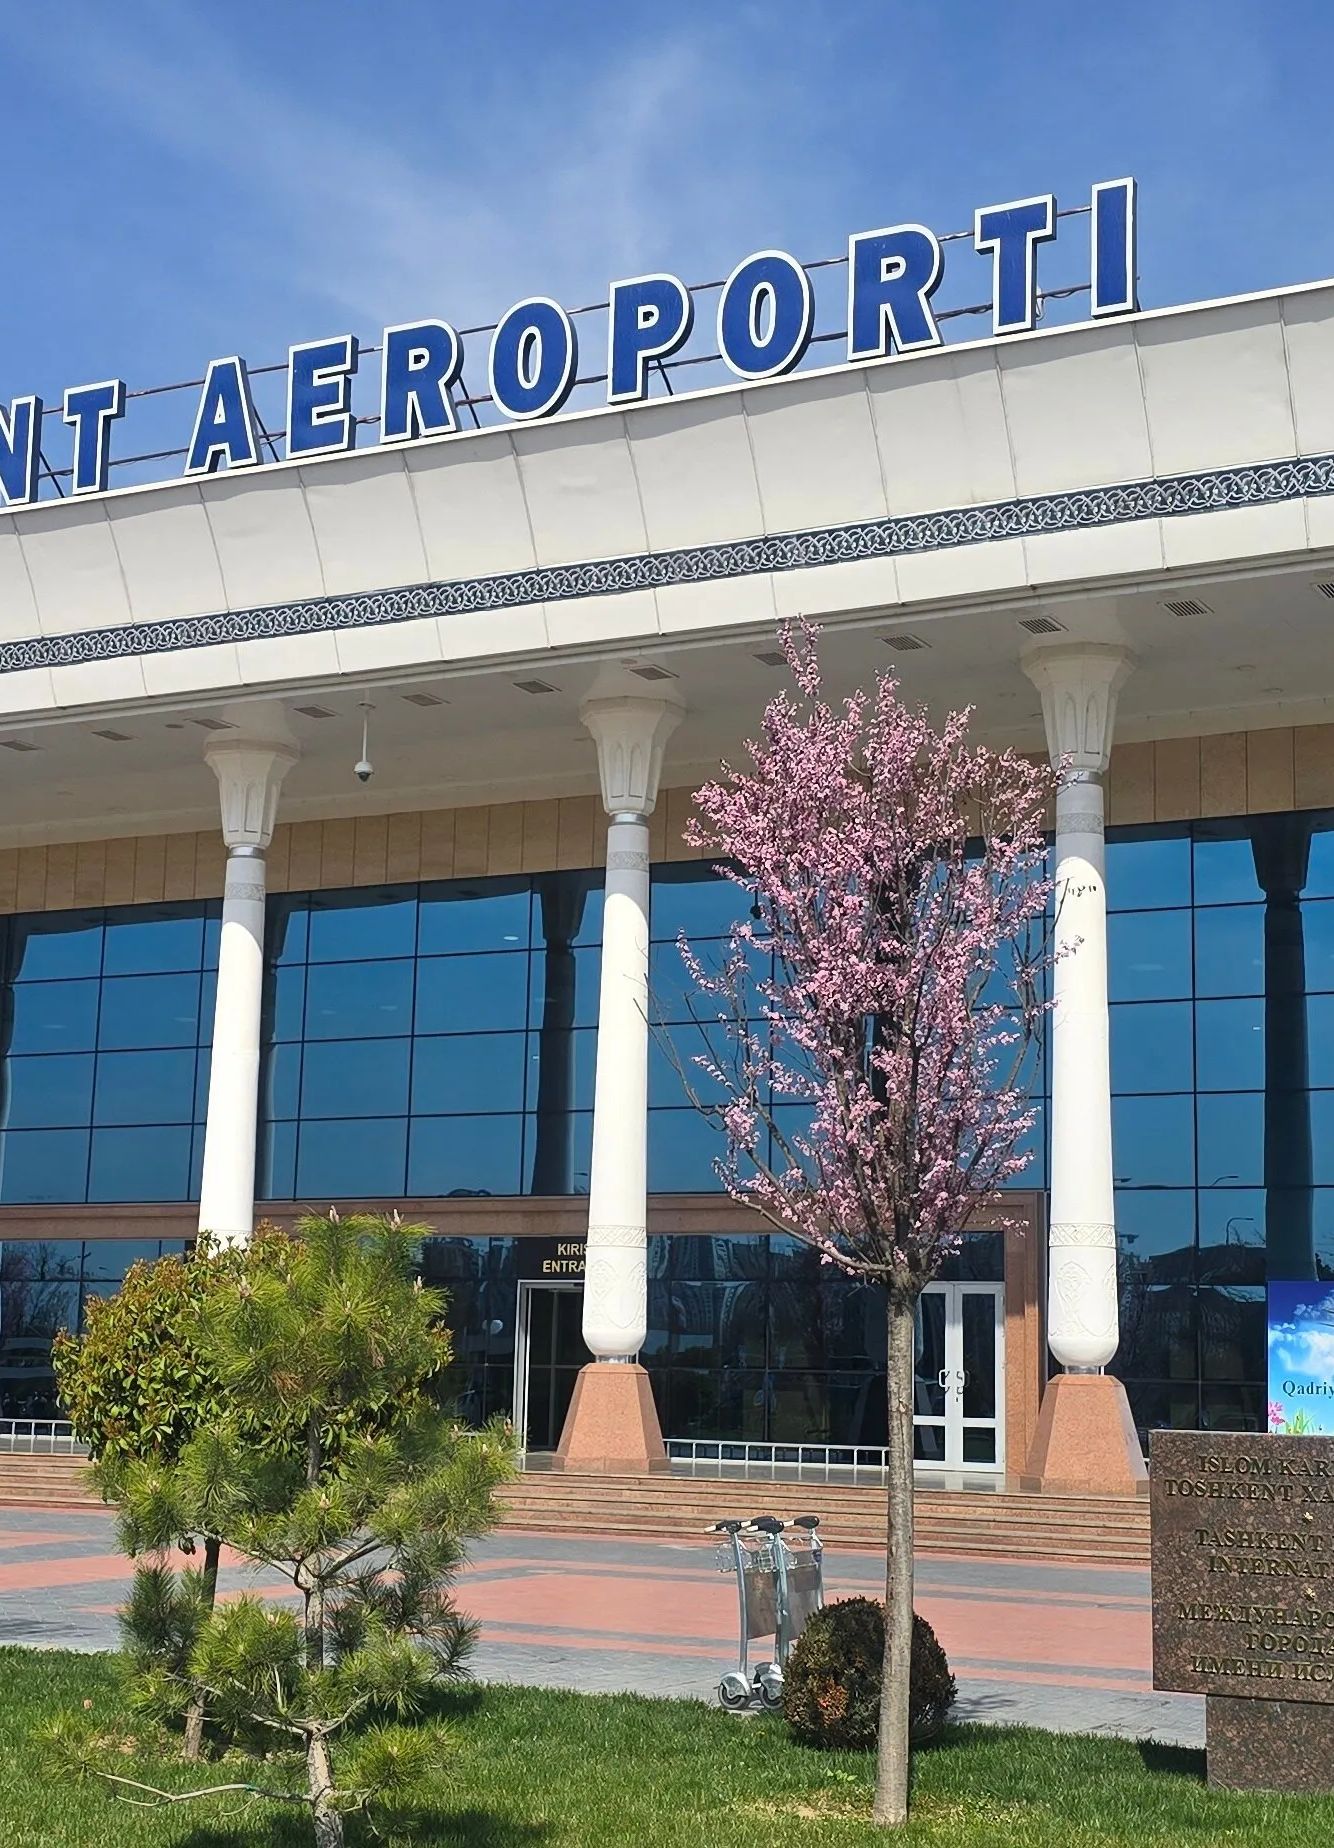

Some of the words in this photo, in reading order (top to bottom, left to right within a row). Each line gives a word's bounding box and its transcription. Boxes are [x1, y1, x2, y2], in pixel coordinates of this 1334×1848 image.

[184, 176, 1140, 476] AEROPORTI
[1197, 1454, 1271, 1475] ISLOM
[1165, 1479, 1294, 1501] TOSHKENT
[1194, 1528, 1323, 1552] TASHKENT
[1190, 1653, 1284, 1680] ИМЕНИ
